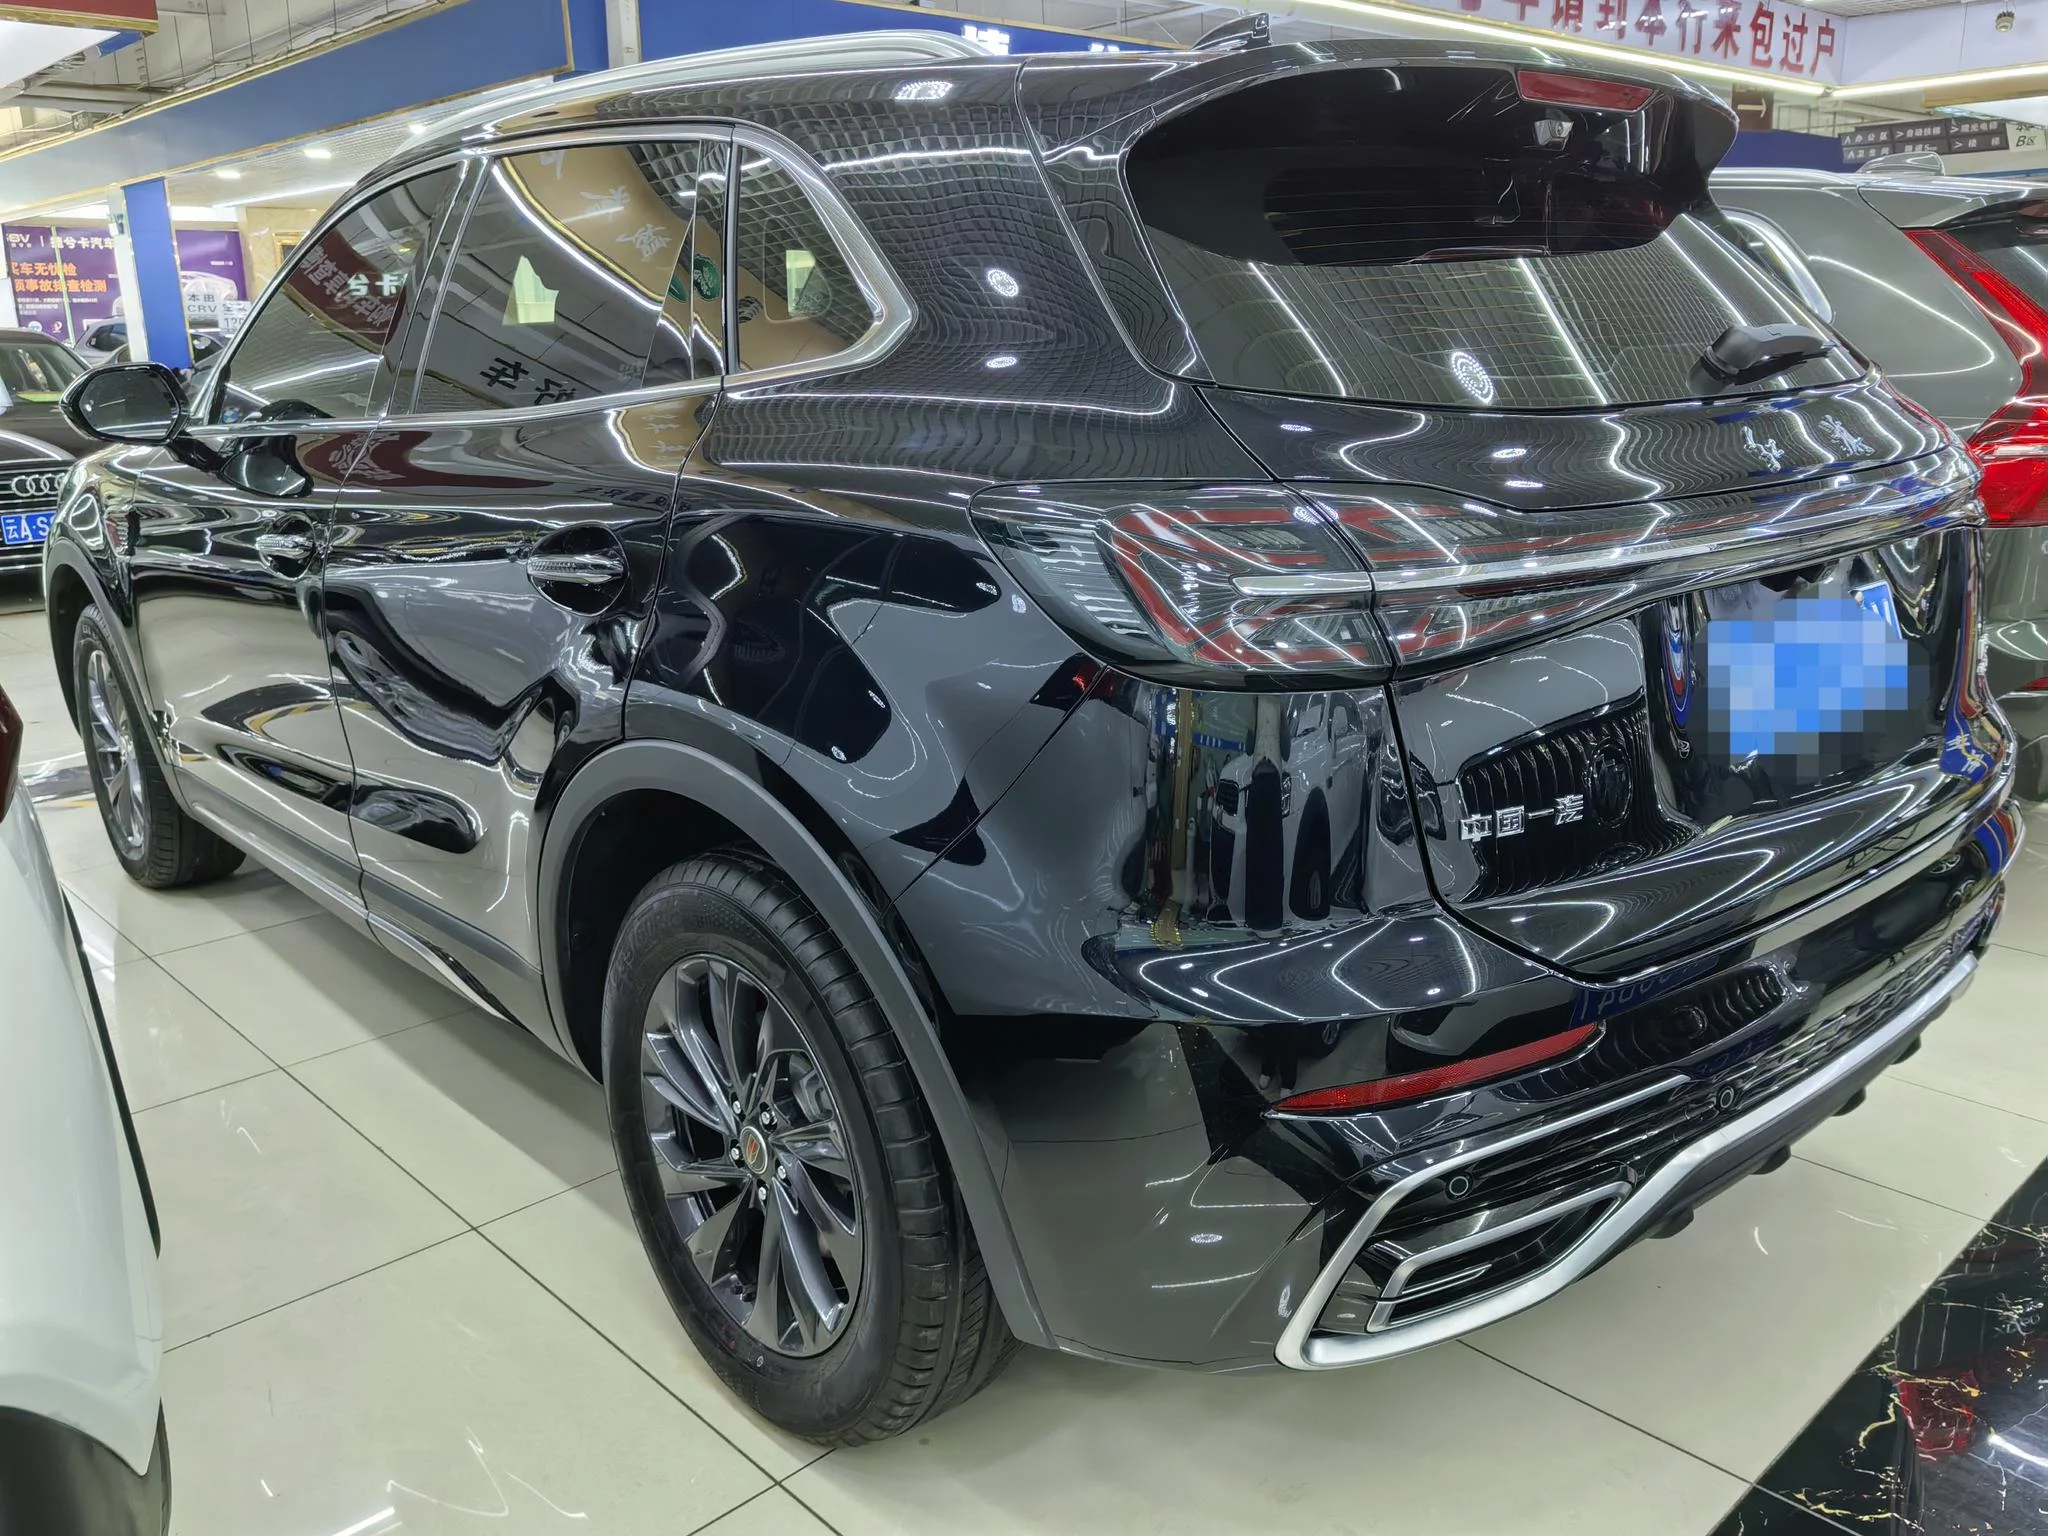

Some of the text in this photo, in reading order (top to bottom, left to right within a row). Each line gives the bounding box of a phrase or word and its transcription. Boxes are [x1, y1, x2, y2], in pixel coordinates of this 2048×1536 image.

[187, 304, 217, 313] CRV
[1460, 794, 1584, 843] 中国一汽
